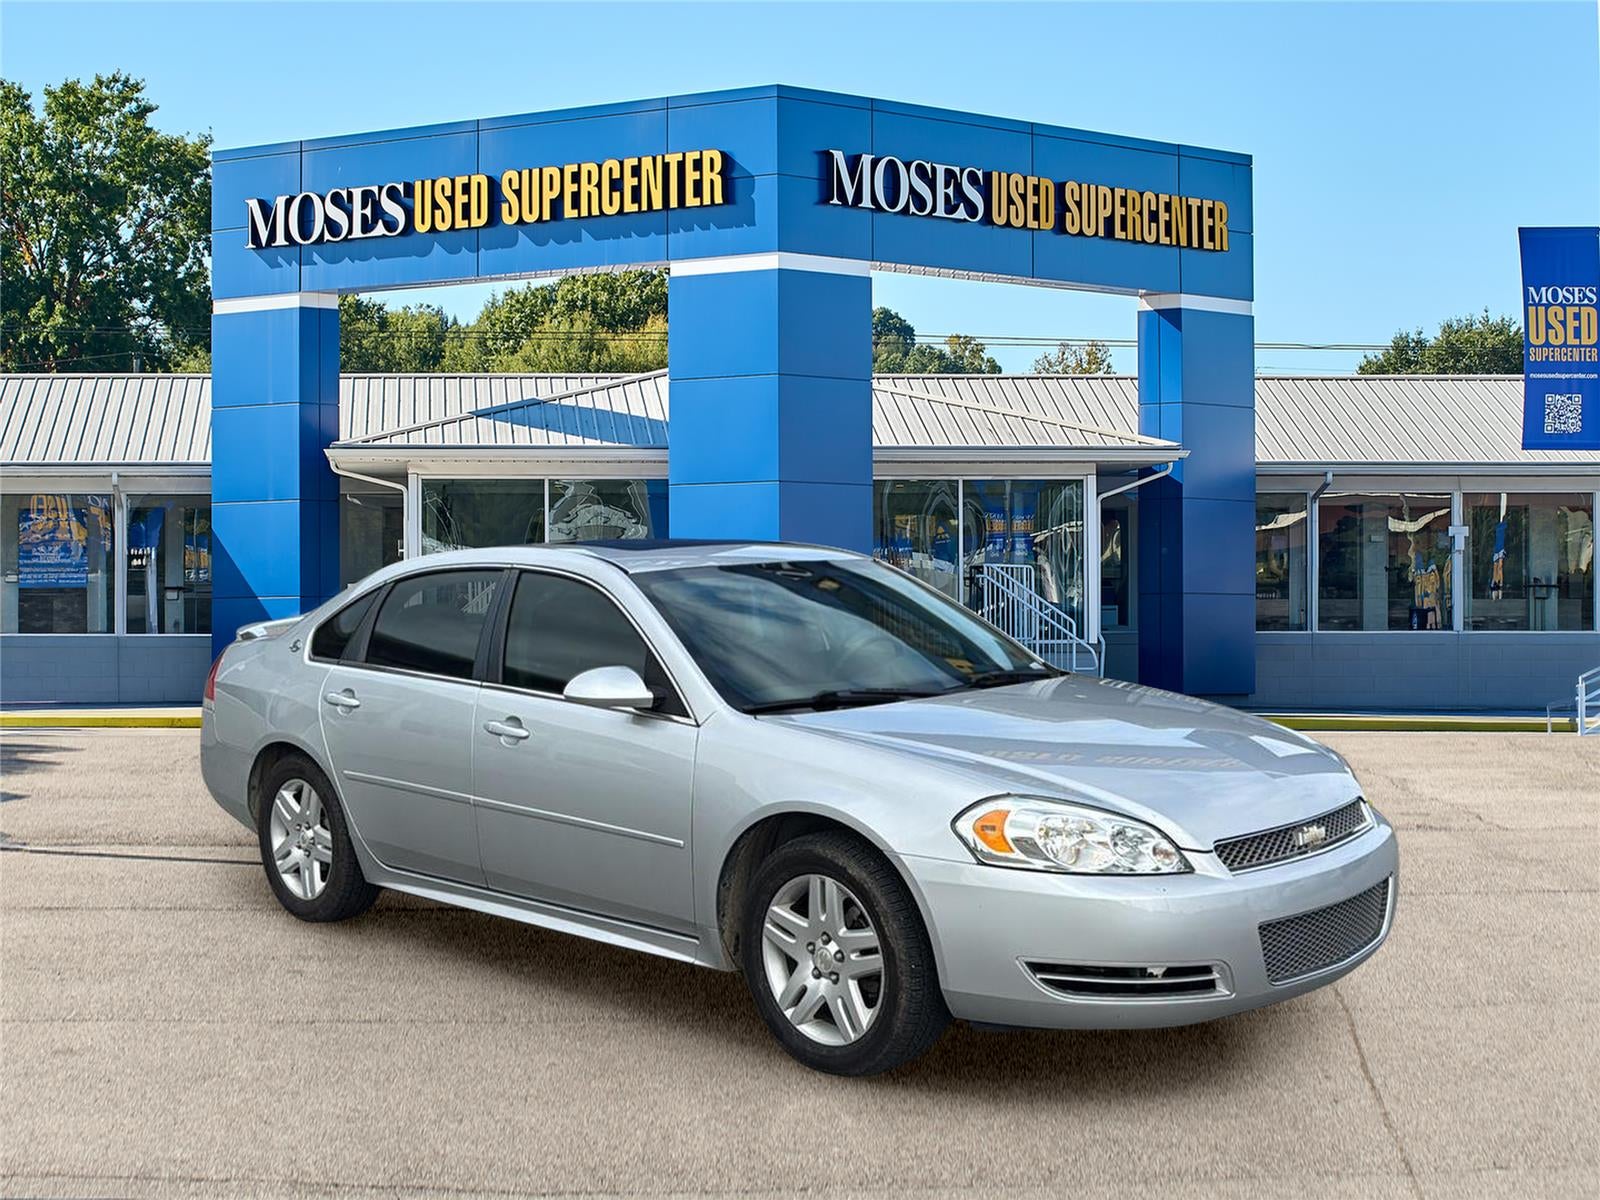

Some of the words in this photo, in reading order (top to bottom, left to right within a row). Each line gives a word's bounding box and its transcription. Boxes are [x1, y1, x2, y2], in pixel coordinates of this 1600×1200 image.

[244, 183, 407, 249] MOSES
[414, 174, 488, 233] USED
[501, 149, 724, 225] SUPERCENTER
[829, 150, 984, 222] MOSES
[991, 171, 1054, 230] USED
[1064, 181, 1229, 251] SUPERCENTER
[1528, 286, 1597, 305] MOSES
[1528, 306, 1598, 346] USED
[1529, 347, 1598, 362] SUPERCENTER
